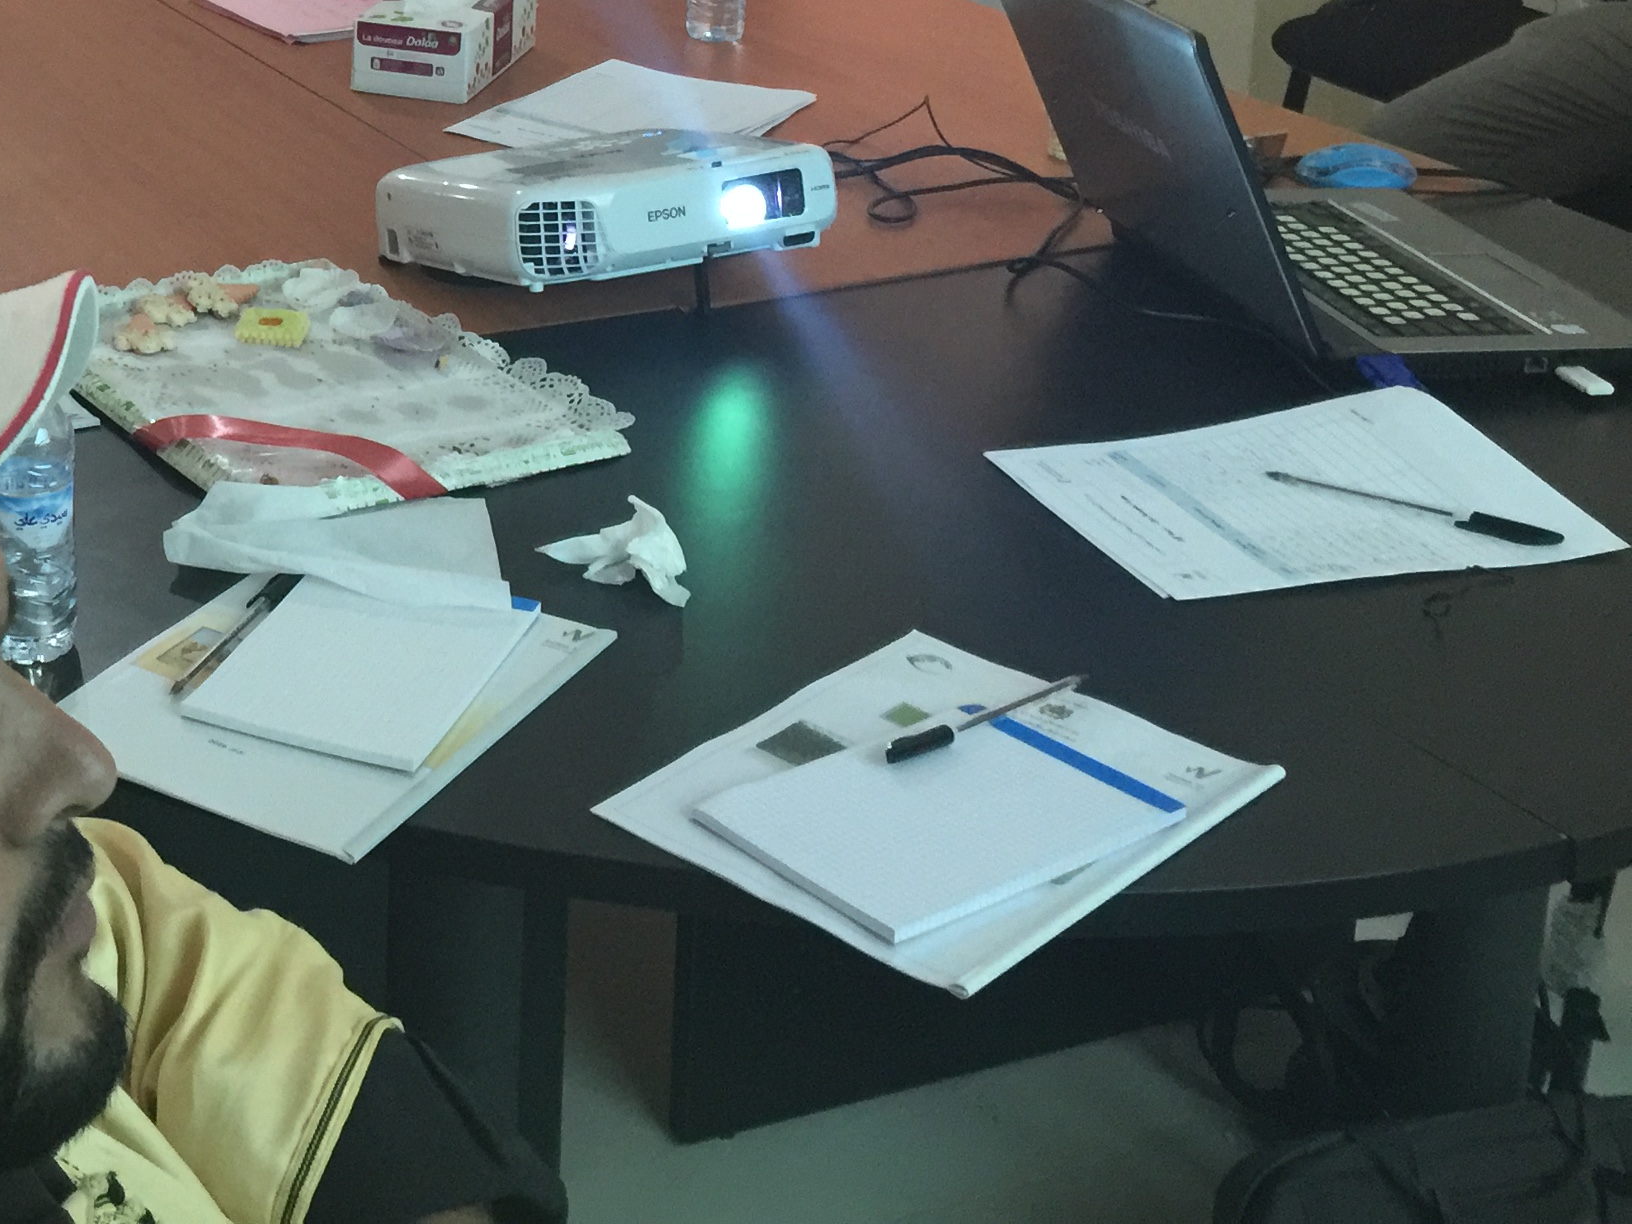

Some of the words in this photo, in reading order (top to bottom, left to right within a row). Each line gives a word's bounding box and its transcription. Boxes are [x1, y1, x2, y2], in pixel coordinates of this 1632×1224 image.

[647, 206, 686, 223] EPSON
[14, 512, 38, 531] علي
[40, 509, 68, 529] سيدي
